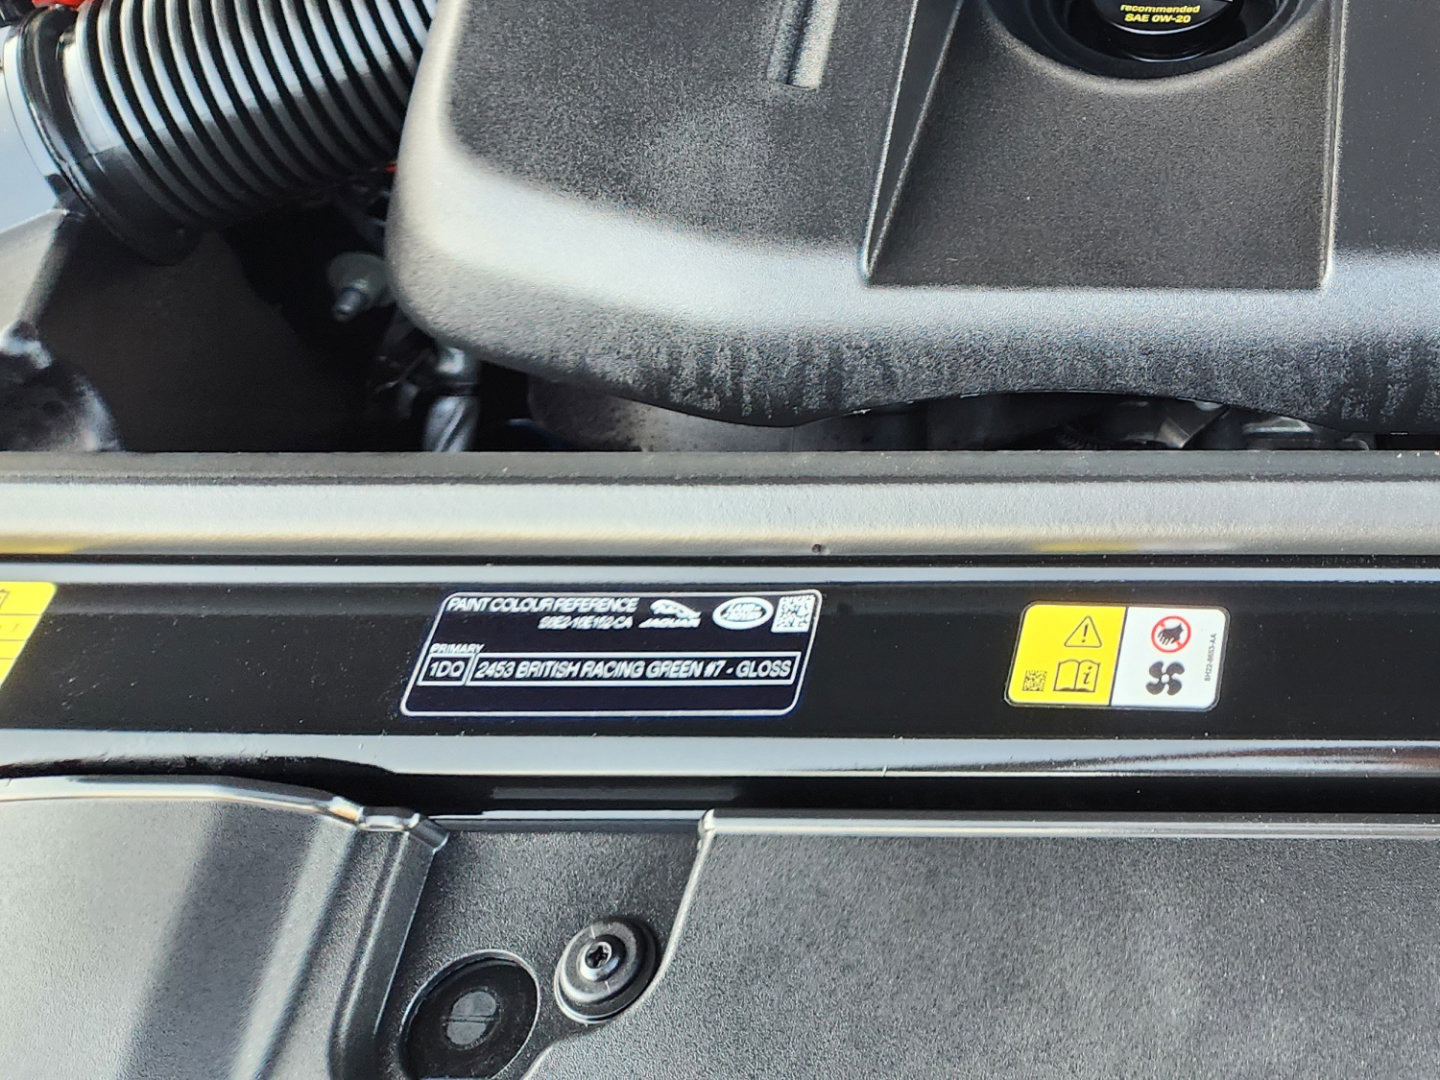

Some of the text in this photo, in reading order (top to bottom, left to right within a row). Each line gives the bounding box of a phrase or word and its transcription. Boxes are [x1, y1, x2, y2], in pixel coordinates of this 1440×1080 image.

[1120, 4, 1201, 14] recommended
[1124, 13, 1192, 24] SAE 0W-20
[447, 597, 640, 612] PAINT COLOUR REFERENCE
[429, 643, 486, 654] PRIMARY
[475, 660, 516, 678] 2453
[515, 660, 581, 678] BRITISH
[579, 660, 646, 678] RACING
[646, 660, 703, 678] GREEN
[735, 659, 792, 678] GLOSS
